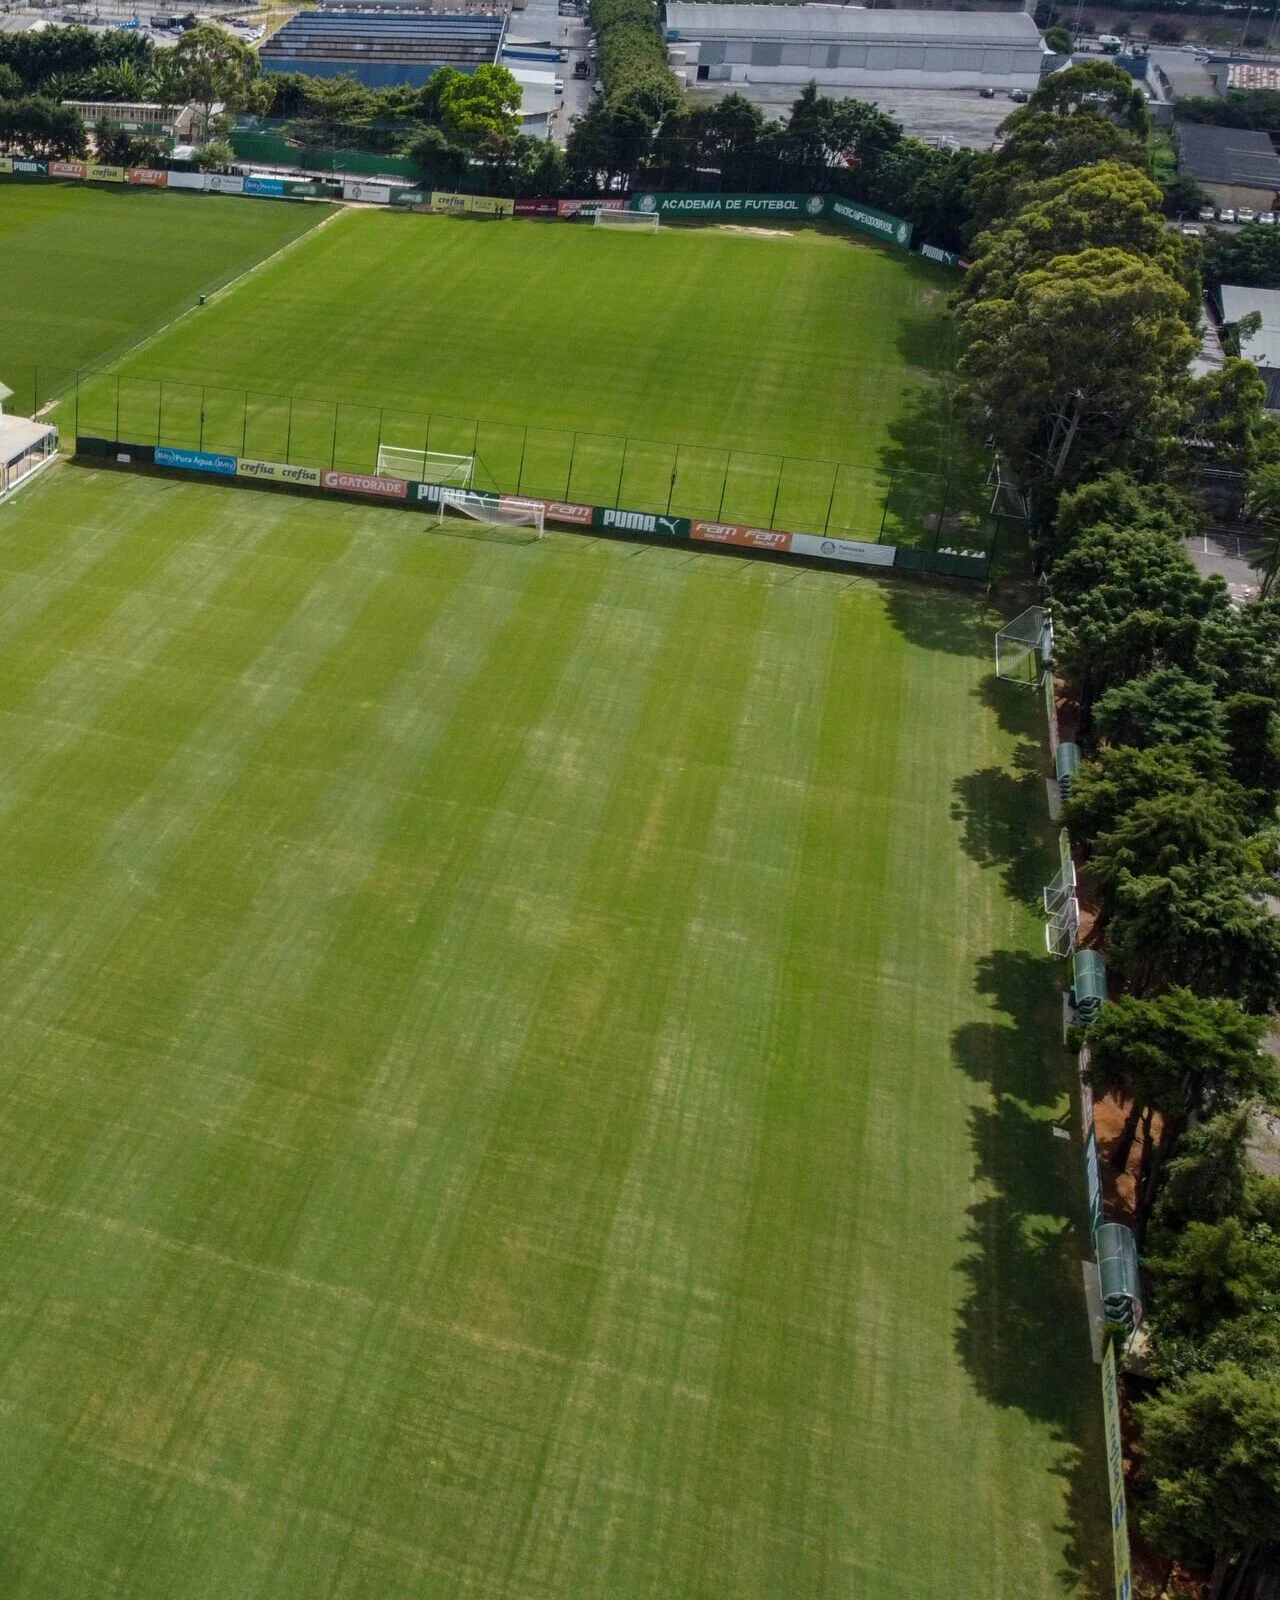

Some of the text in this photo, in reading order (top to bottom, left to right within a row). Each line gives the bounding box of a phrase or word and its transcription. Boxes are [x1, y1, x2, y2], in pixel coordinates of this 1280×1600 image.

[662, 200, 799, 210] ACADEMIA DE FUTEBOL
[240, 462, 317, 481] crefisa crefisa
[339, 476, 401, 493] GATORADE
[603, 509, 656, 532] PUMA
